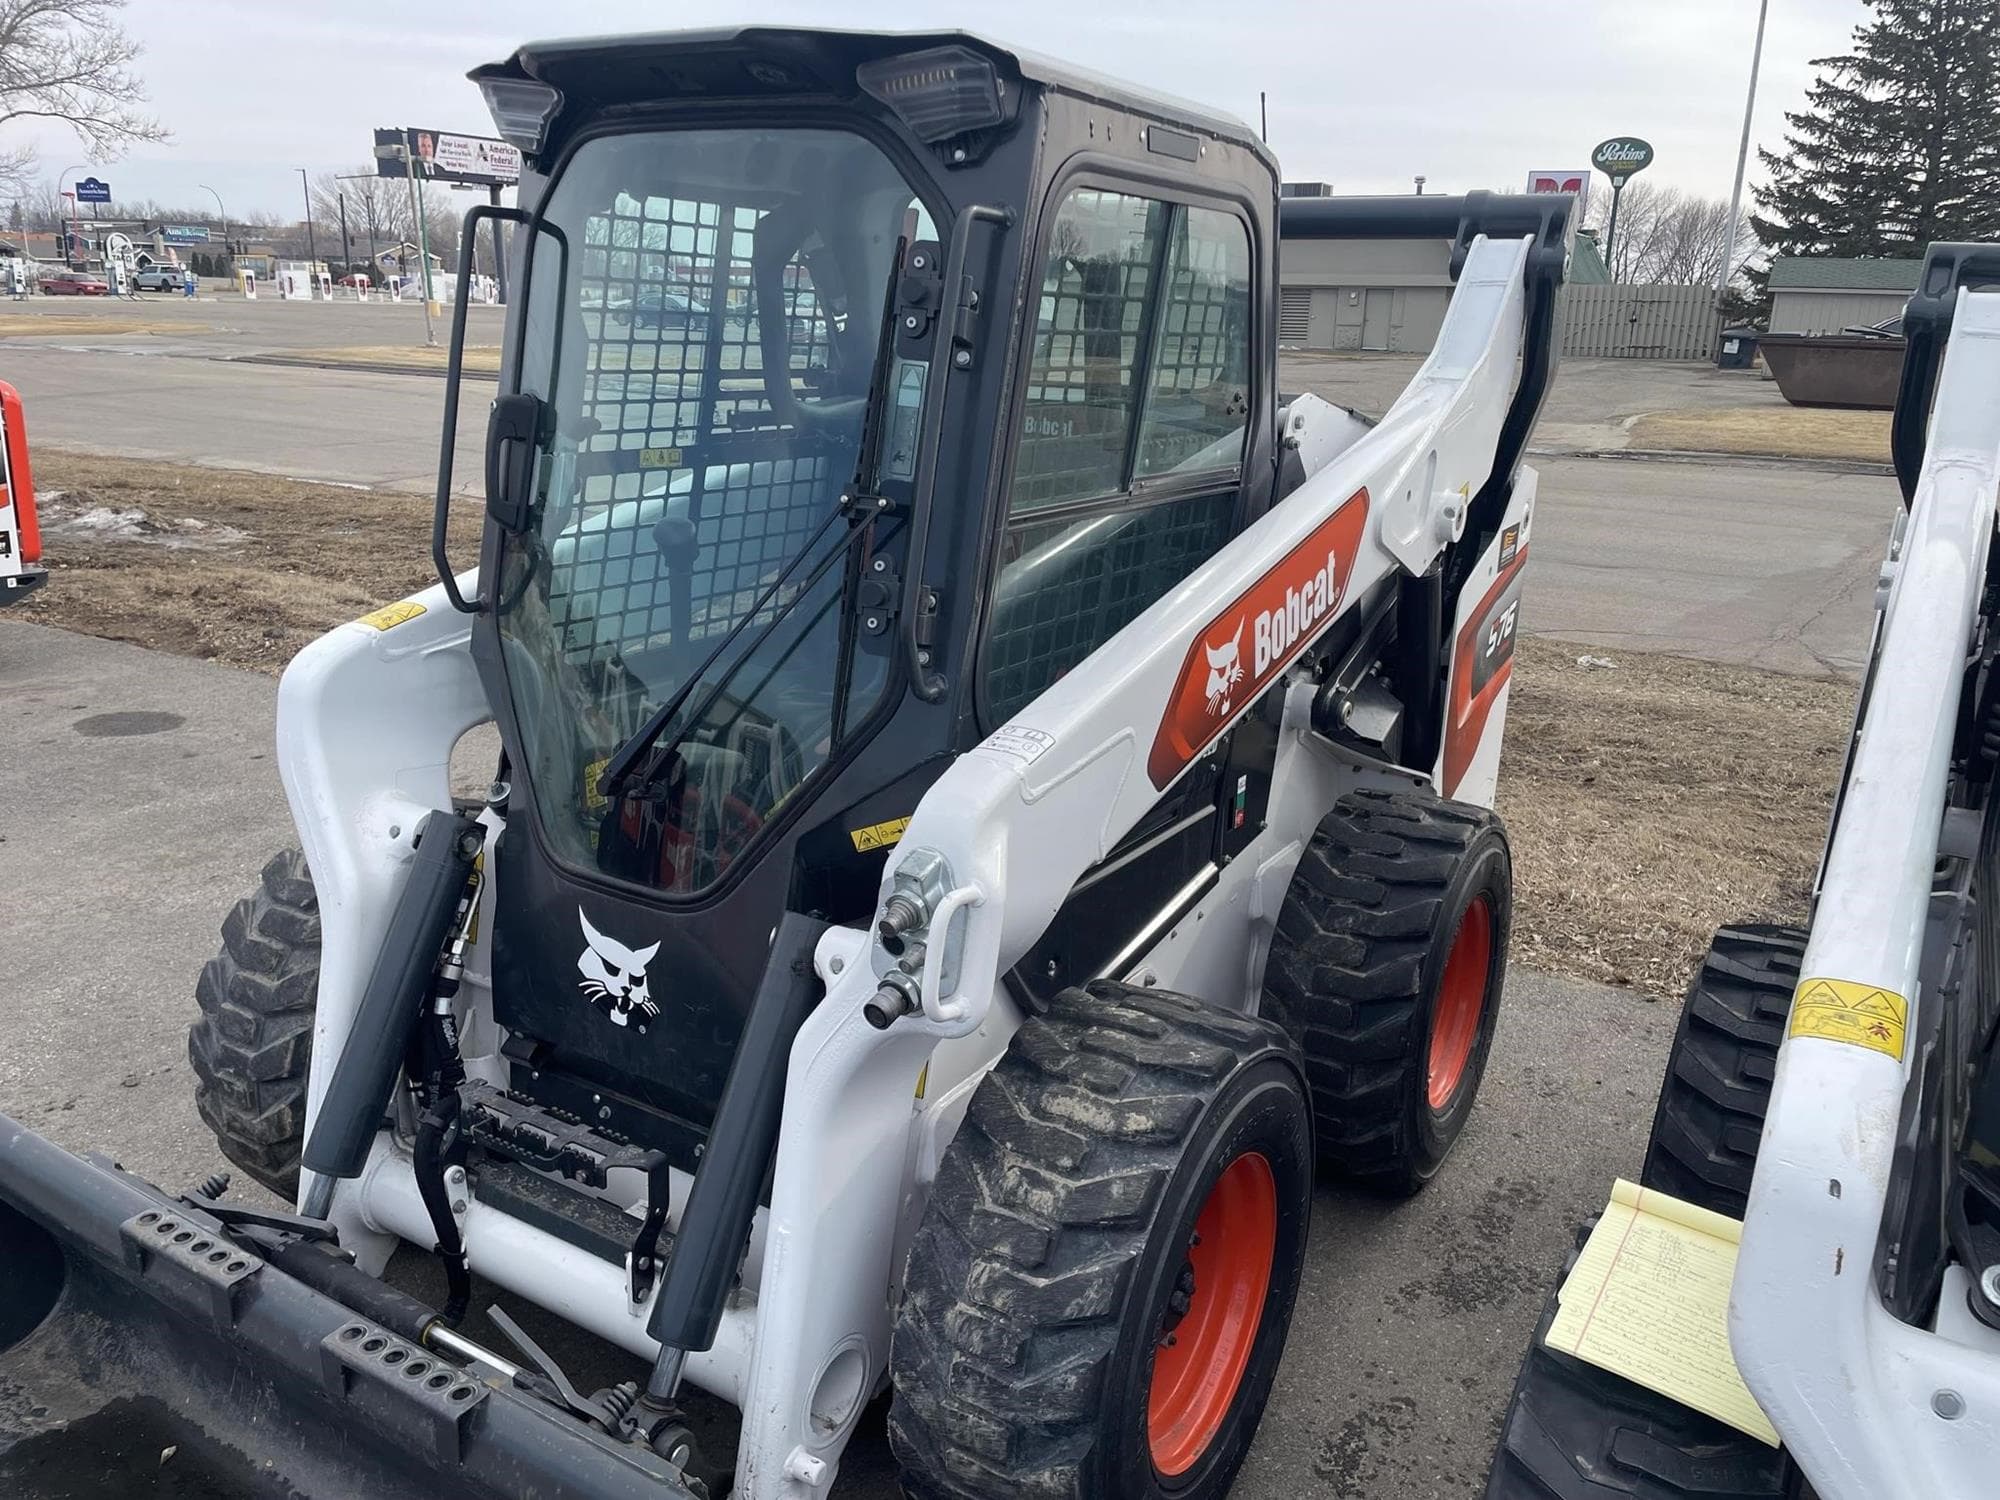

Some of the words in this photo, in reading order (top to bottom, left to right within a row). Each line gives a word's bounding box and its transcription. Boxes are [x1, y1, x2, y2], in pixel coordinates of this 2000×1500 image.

[489, 144, 518, 155] American
[490, 154, 513, 165] Federal
[1597, 142, 1646, 162] Perkins
[1254, 549, 1336, 680] Bobcat
[1486, 600, 1518, 659] S76
